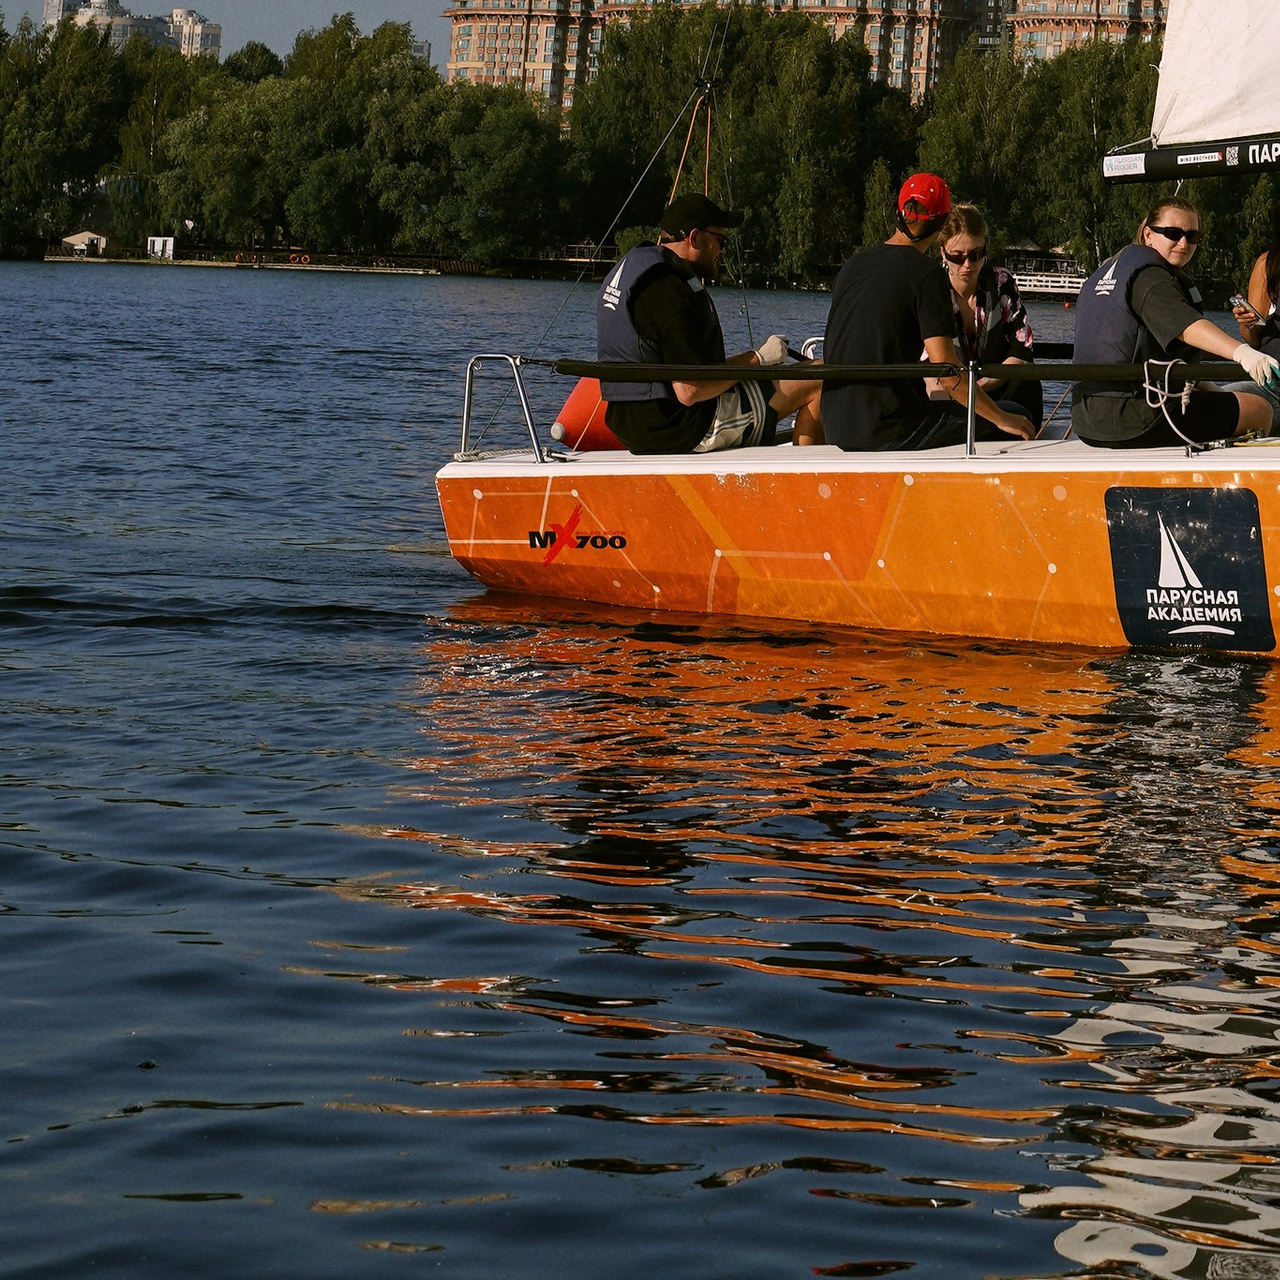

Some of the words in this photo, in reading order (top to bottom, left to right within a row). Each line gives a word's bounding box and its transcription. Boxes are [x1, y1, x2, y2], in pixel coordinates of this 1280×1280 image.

[528, 504, 627, 567] MX700
[1146, 588, 1239, 605] ПАРУСНАЯ
[1147, 606, 1242, 622] АКАДЕМИЯ
